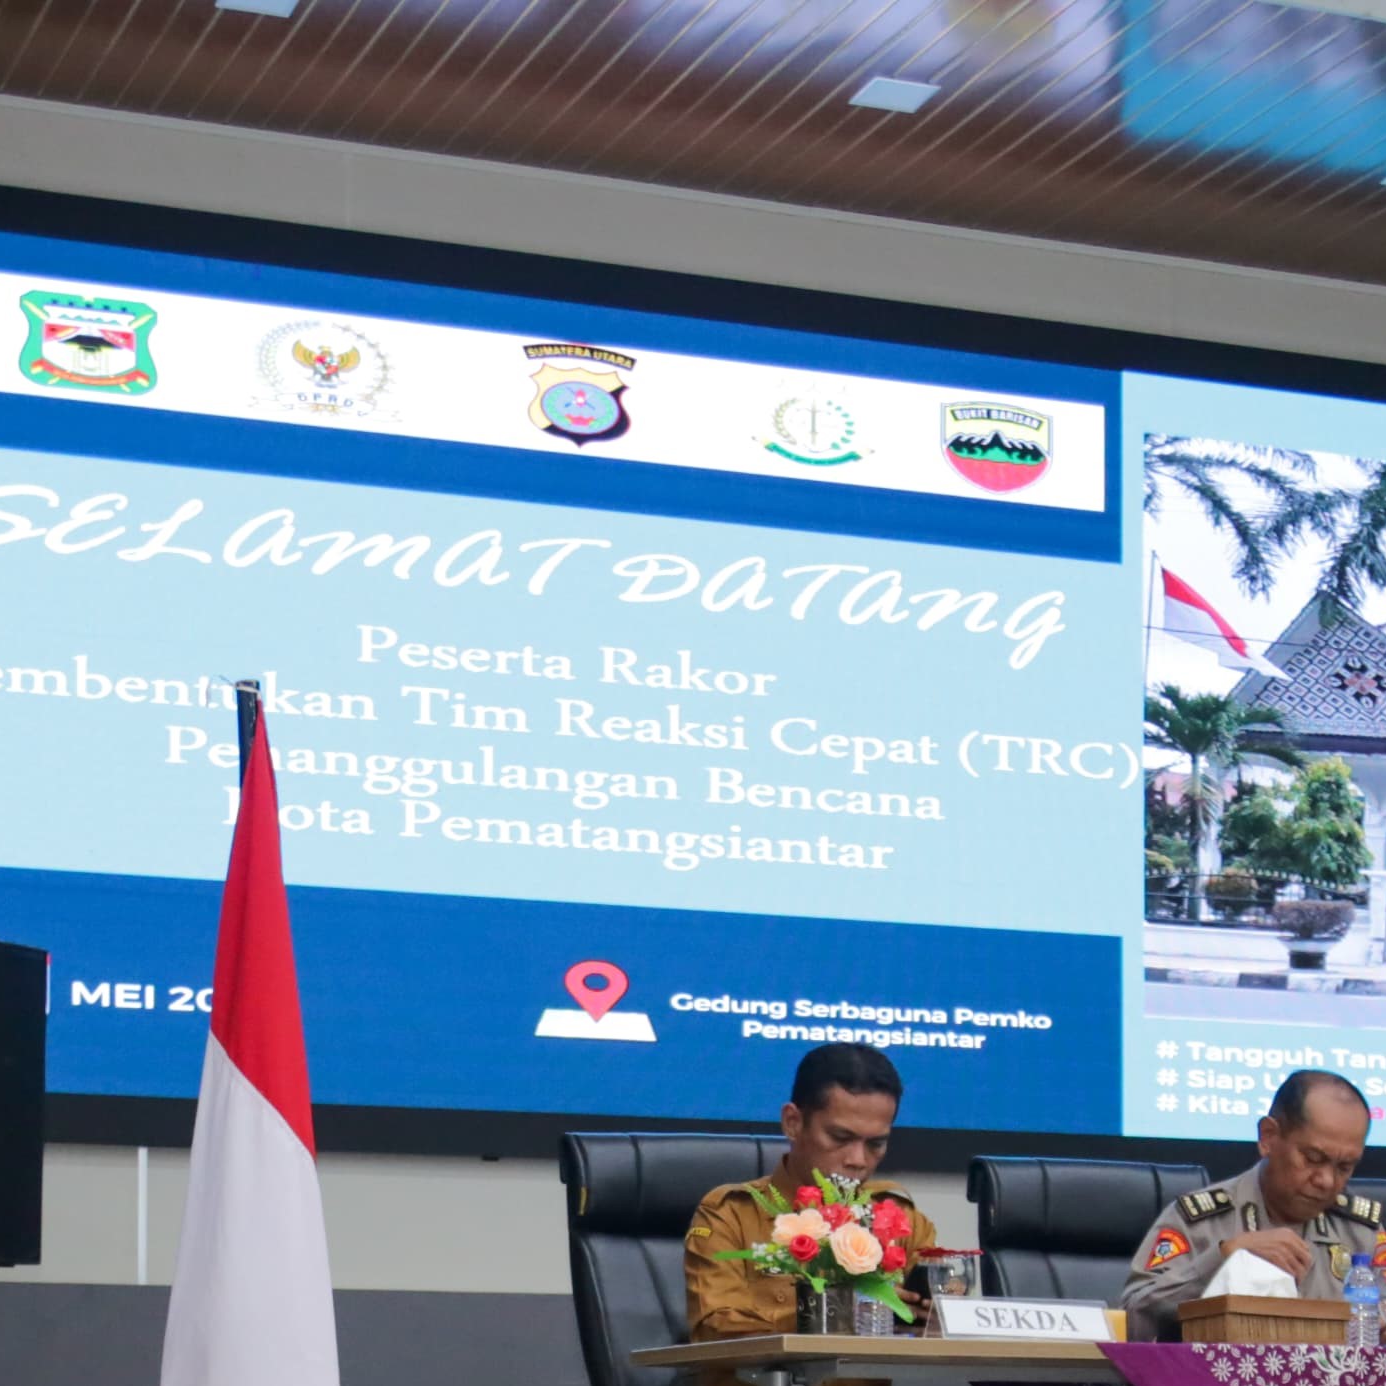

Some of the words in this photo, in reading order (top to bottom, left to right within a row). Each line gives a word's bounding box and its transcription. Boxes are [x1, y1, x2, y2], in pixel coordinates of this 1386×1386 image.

[593, 350, 632, 366] UTARA
[357, 624, 575, 682] Peserta
[599, 646, 777, 697] Rakor
[400, 685, 530, 733] Tim
[555, 698, 749, 751] Reaksi
[770, 717, 939, 773] Cepat
[958, 731, 1139, 789] (TRC)
[705, 766, 945, 821] Bencana
[398, 800, 894, 871] Pematangsiantar
[71, 981, 155, 1010] MEI
[168, 986, 214, 1013] 20
[670, 993, 788, 1019] Gedung
[794, 999, 947, 1025] Serbaguna
[954, 1007, 1053, 1030] Pemko
[742, 1020, 987, 1049] Pematangsiantar
[1186, 1041, 1324, 1068] Tangguh
[1187, 1069, 1255, 1093] Siap
[1188, 1095, 1249, 1115] Kita
[974, 1306, 1079, 1332] SEKDA
